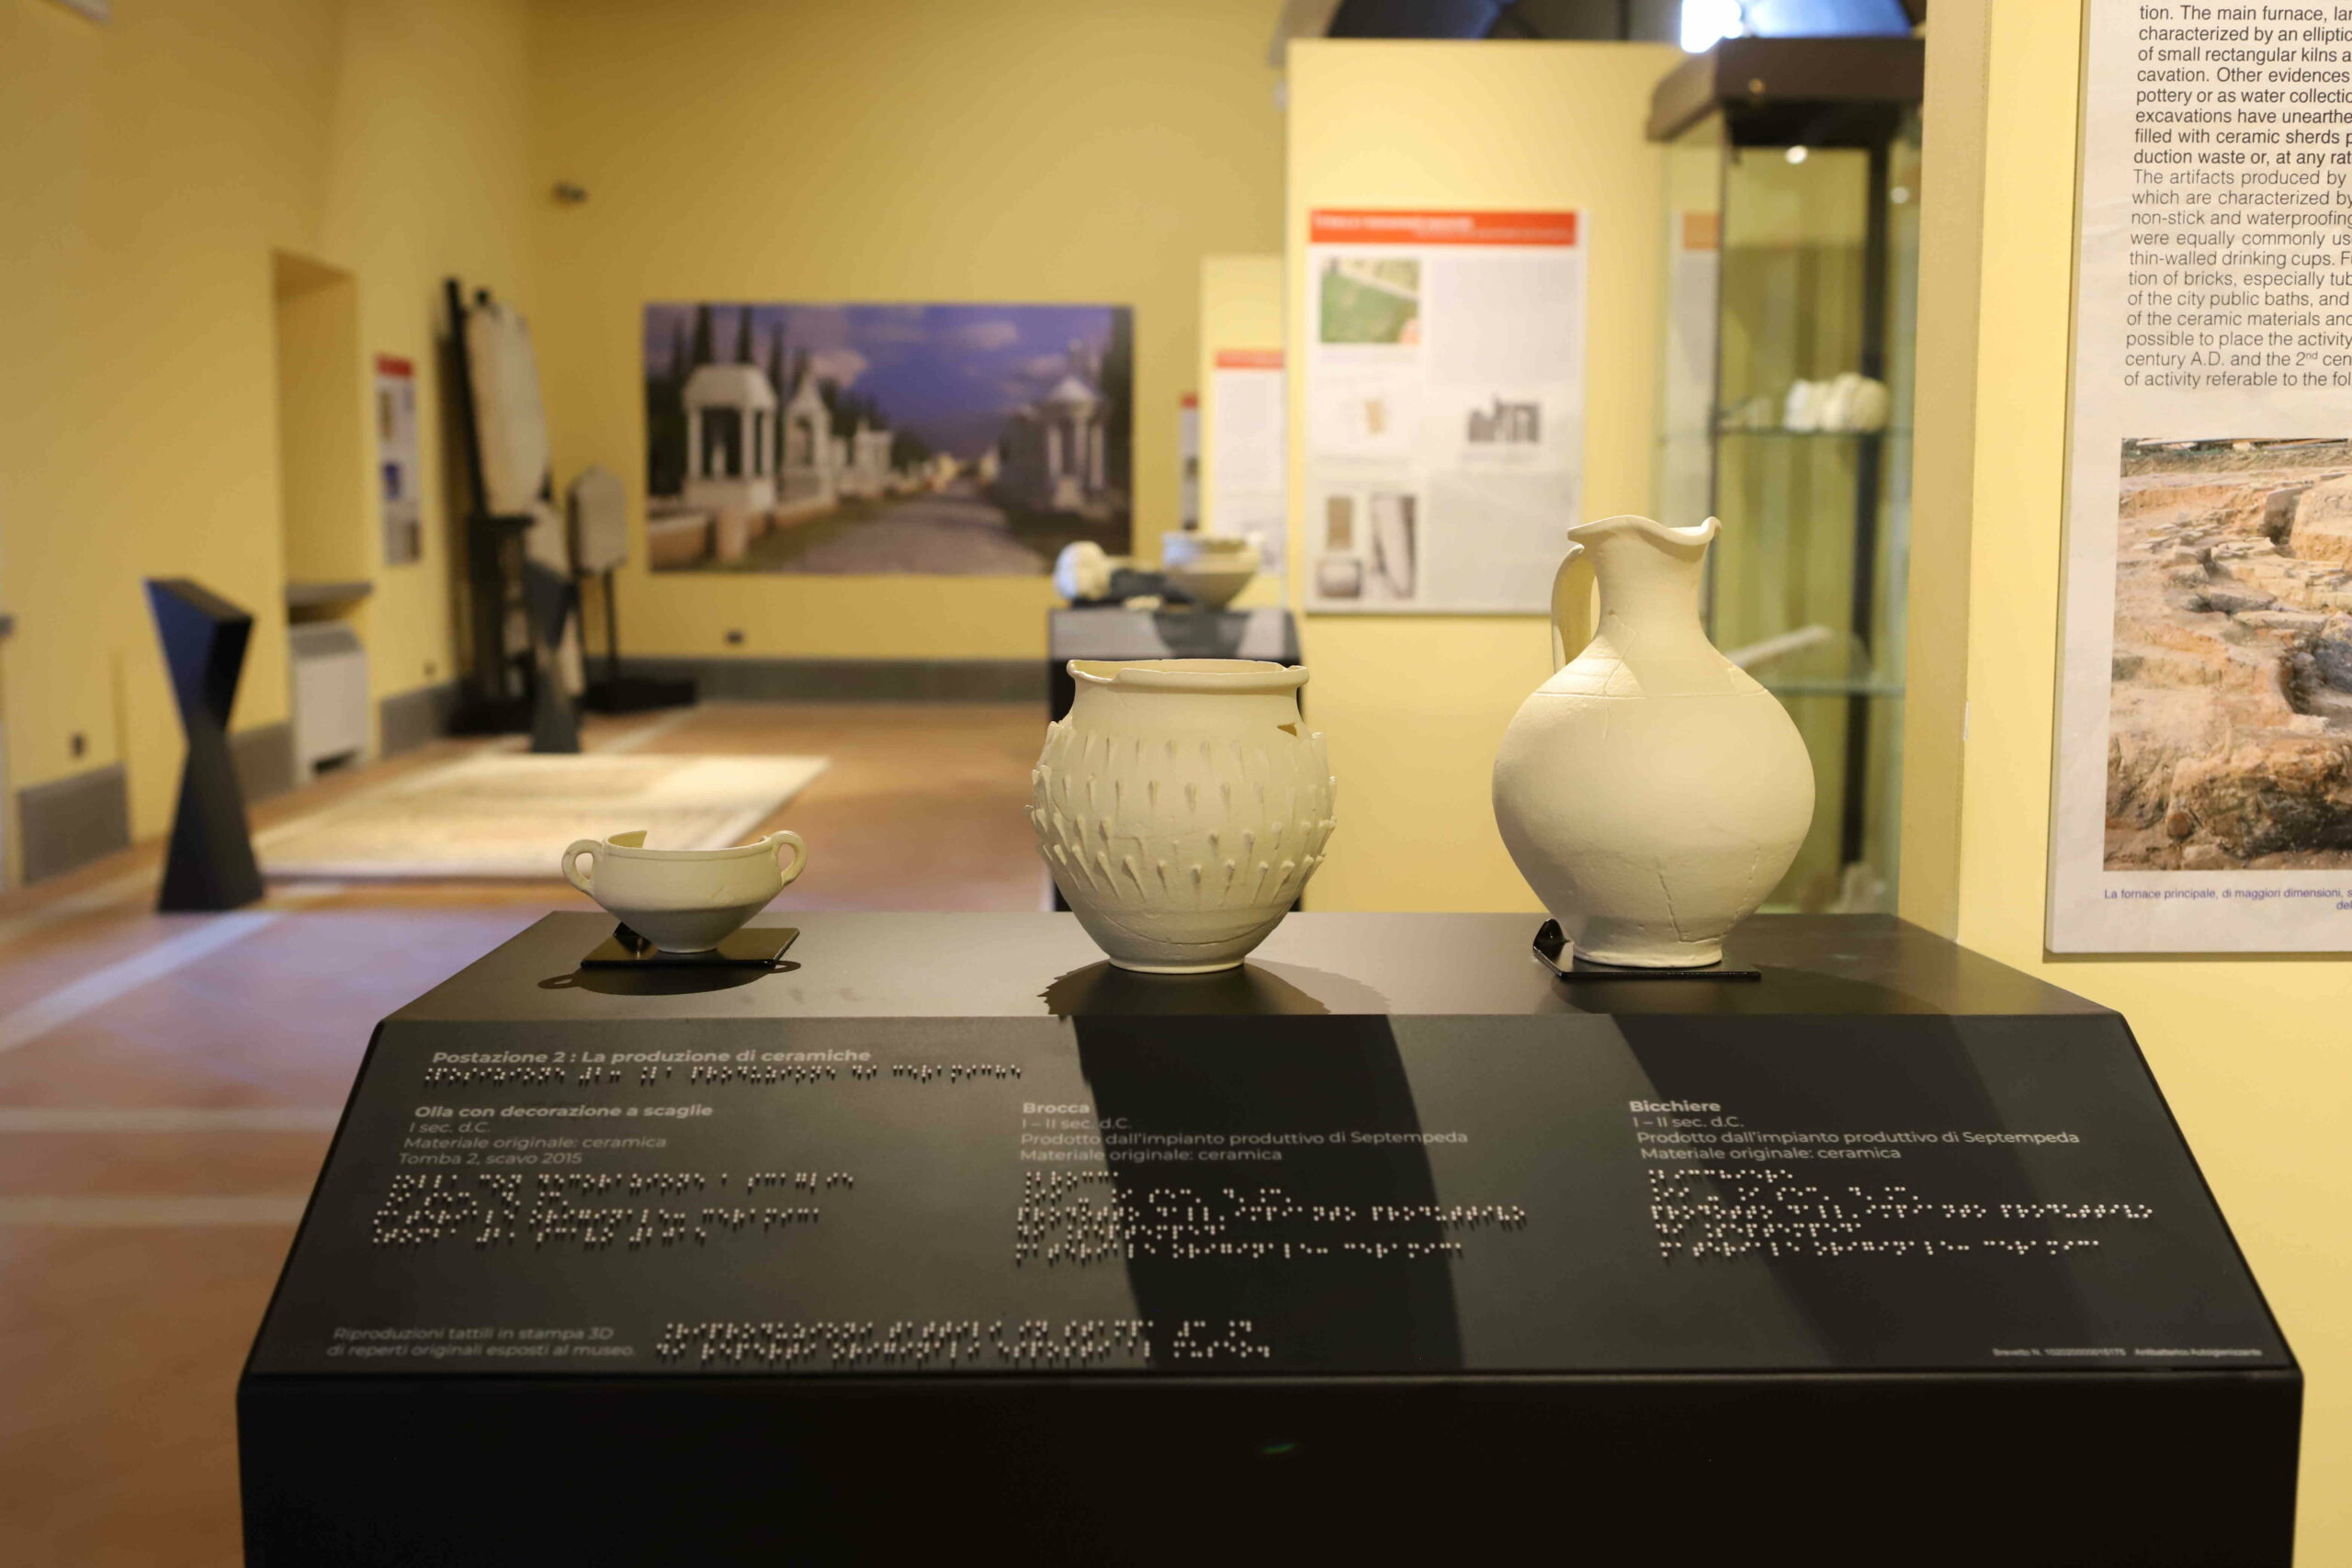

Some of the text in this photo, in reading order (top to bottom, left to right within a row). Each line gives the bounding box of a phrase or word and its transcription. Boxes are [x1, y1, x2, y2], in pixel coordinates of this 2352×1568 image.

[2140, 5, 2173, 20] tion.
[2180, 5, 2211, 20] The
[2218, 6, 2256, 20] main
[2263, 6, 2326, 23] furnace,
[2139, 26, 2248, 41] characterized
[2255, 27, 2273, 45] by
[2278, 30, 2297, 41] an
[2138, 46, 2154, 61] of
[2158, 47, 2200, 62] small
[2206, 47, 2297, 65] rectangular
[2301, 47, 2337, 62] kilns
[2137, 67, 2350, 83] cavation. Other evidences
[2137, 88, 2192, 106] pottery
[2197, 91, 2213, 102] or
[2218, 91, 2236, 103] as
[2241, 89, 2285, 103] water
[2136, 108, 2232, 123] excavations
[2238, 108, 2276, 123] have
[2135, 129, 2172, 143] filled
[2178, 129, 2210, 143] with
[2216, 129, 2279, 143] ceramic
[2286, 130, 2340, 144] sherds
[2134, 149, 2192, 164] duction
[2199, 151, 2245, 164] waste
[2251, 152, 2269, 166] or,
[2276, 151, 2291, 164] at
[2297, 153, 2325, 168] any
[2133, 169, 2346, 188] The artifacts produced by
[2132, 189, 2179, 204] which
[2186, 193, 2211, 205] are
[2219, 190, 2329, 205] characterized
[2132, 210, 2205, 225] non-stick
[2211, 210, 2241, 225] and
[2131, 231, 2352, 249] were equally commonly us
[2130, 251, 2217, 265] thin-walled
[2222, 251, 2286, 269] drinking
[2291, 254, 2335, 269] cups.
[2129, 271, 2157, 286] tion
[2164, 270, 2178, 286] of
[2185, 271, 2236, 287] bricks,
[2244, 271, 2324, 289] especially
[2128, 290, 2349, 309] of the city public baths, and
[2127, 310, 2142, 326] of
[2147, 311, 2172, 325] the
[2177, 311, 2242, 326] ceramic
[2247, 311, 2320, 326] materials
[2127, 331, 2194, 349] possible
[2199, 333, 2213, 345] to
[2219, 331, 2264, 349] place
[2268, 332, 2293, 345] the
[2125, 353, 2186, 369] century
[2190, 351, 2224, 366] A.D.
[2231, 352, 2261, 366] and
[2267, 352, 2290, 366] the
[2323, 355, 2352, 367] cen
[2124, 371, 2351, 389] of activity referable to the fol
[2105, 889, 2118, 899] La
[2121, 889, 2161, 899] fornace
[2222, 889, 2232, 898] di
[2234, 888, 2280, 900] maggiori
[432, 1051, 548, 1064] Postazione
[552, 1052, 565, 1063] 2
[582, 1052, 606, 1063] La
[611, 1050, 730, 1066] produzione
[736, 1049, 756, 1063] di
[761, 1049, 872, 1063] ceramiche
[414, 1104, 714, 1119] Olla con decorazione a scaglie
[1023, 1102, 1091, 1114] Brocca
[1629, 1100, 1721, 1112] Bicchiere
[403, 1136, 667, 1150] Materiale originale: ceramica
[1021, 1133, 1102, 1145] Prodotto
[1229, 1133, 1325, 1146] produttivo
[1329, 1131, 1346, 1143] di
[1350, 1131, 1468, 1145] Septempeda
[1636, 1131, 1717, 1144] Prodotto
[1843, 1131, 1939, 1145] produttivo
[1941, 1131, 1960, 1143] di
[1962, 1131, 2081, 1145] Septempeda
[399, 1153, 461, 1165] Tomba
[486, 1155, 538, 1165] scavo
[541, 1153, 582, 1165] 2015
[1020, 1149, 1283, 1163] Materiale originale: ceramica
[1641, 1147, 1902, 1161] Materiale originale: ceramica
